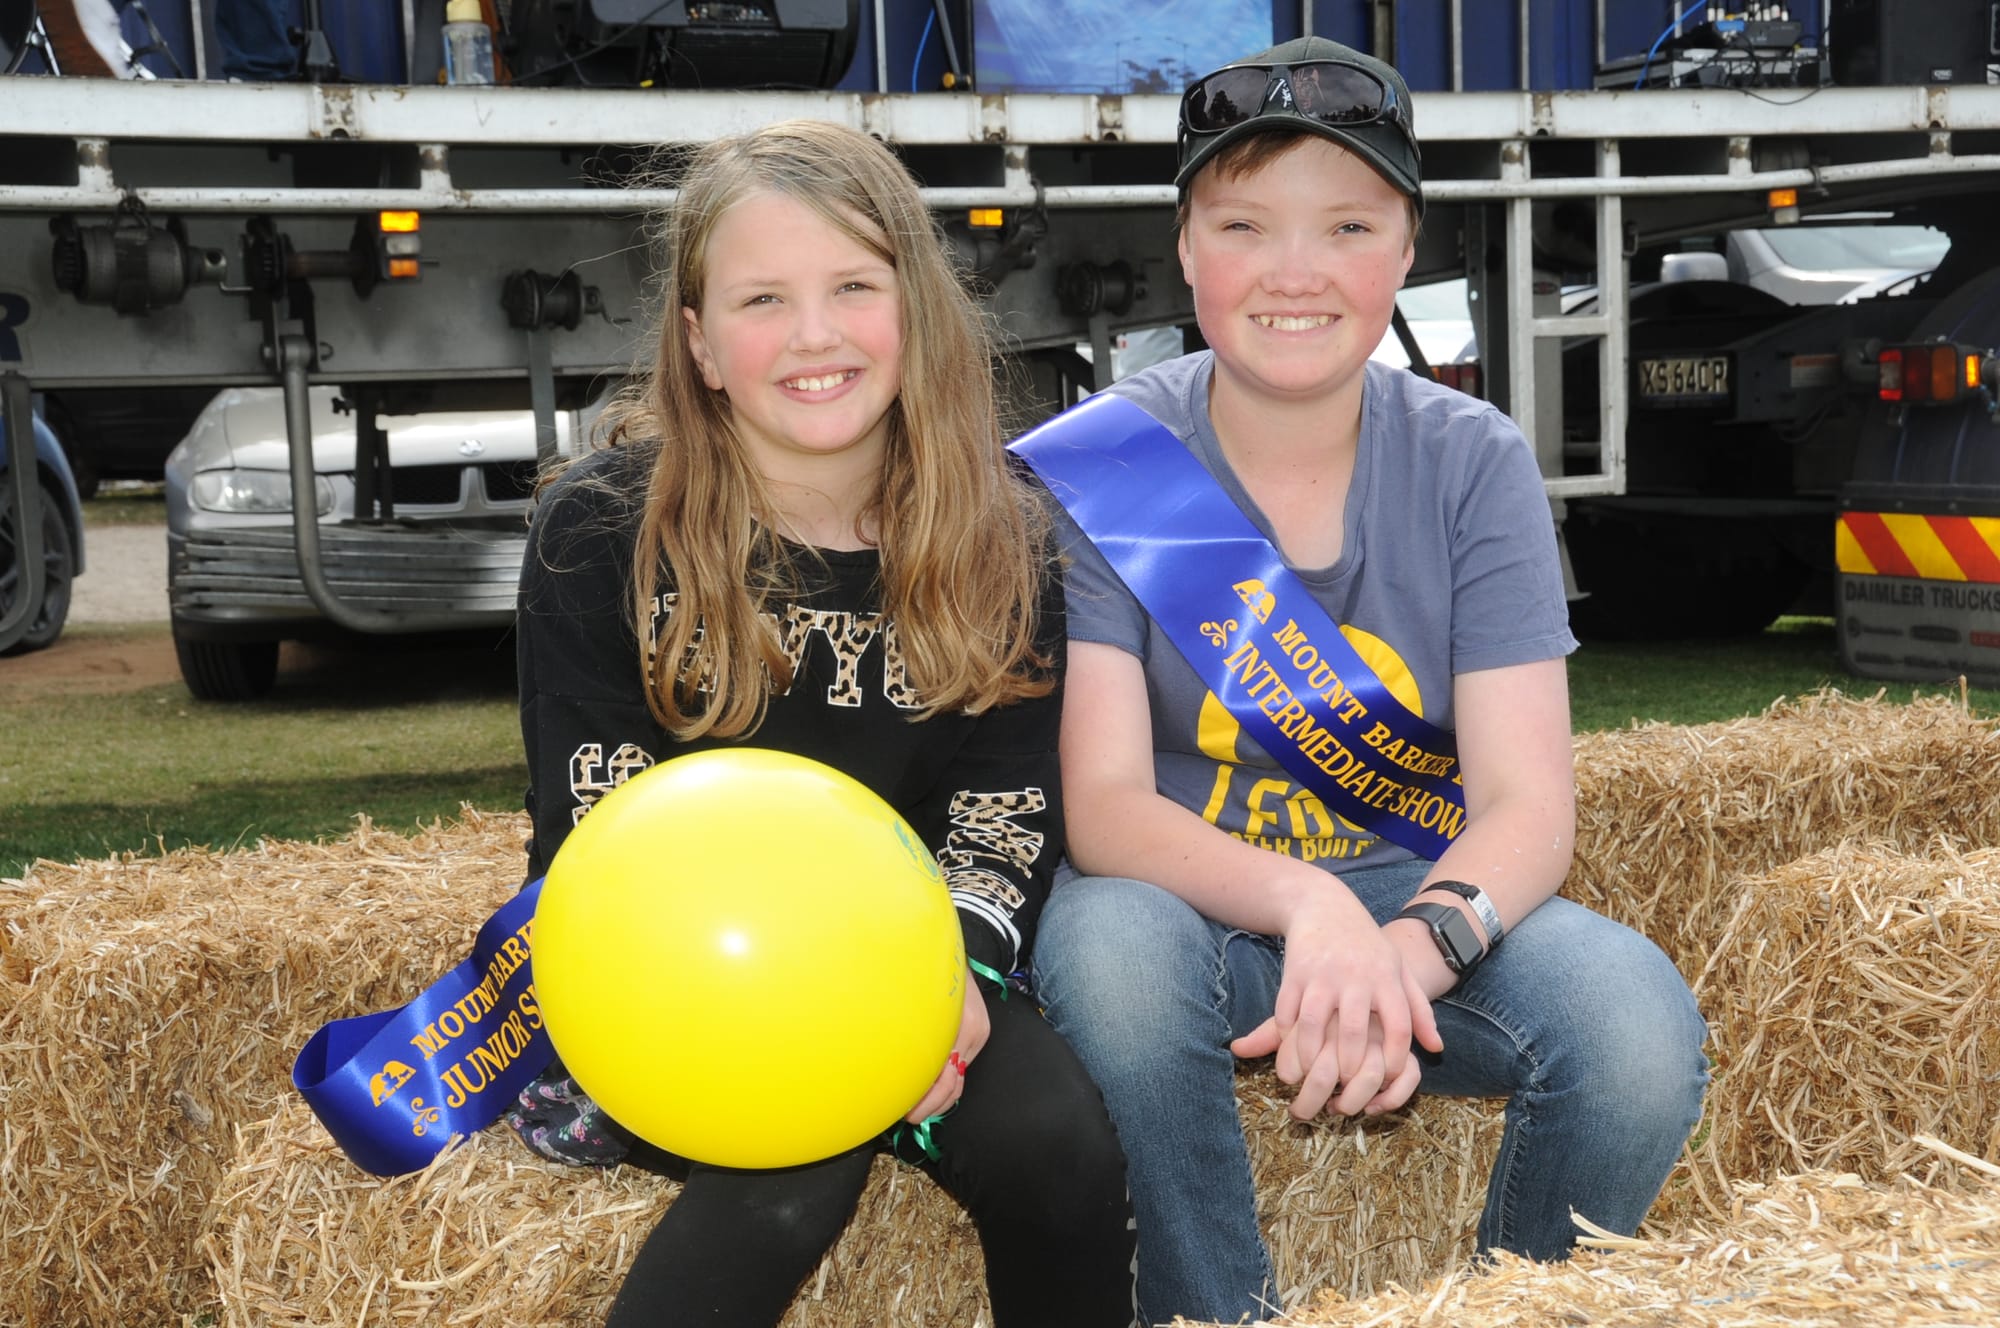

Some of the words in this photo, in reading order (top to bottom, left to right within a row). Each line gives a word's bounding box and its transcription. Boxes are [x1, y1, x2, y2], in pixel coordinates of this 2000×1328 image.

[1845, 581, 1925, 607] DAIMLER
[1224, 640, 1403, 808] INTERMEDIATE
[1272, 618, 1368, 724] MOUNT
[1360, 721, 1456, 777] BARKER
[410, 973, 500, 1060] MOUNT
[440, 1010, 532, 1108] JUNIOR
